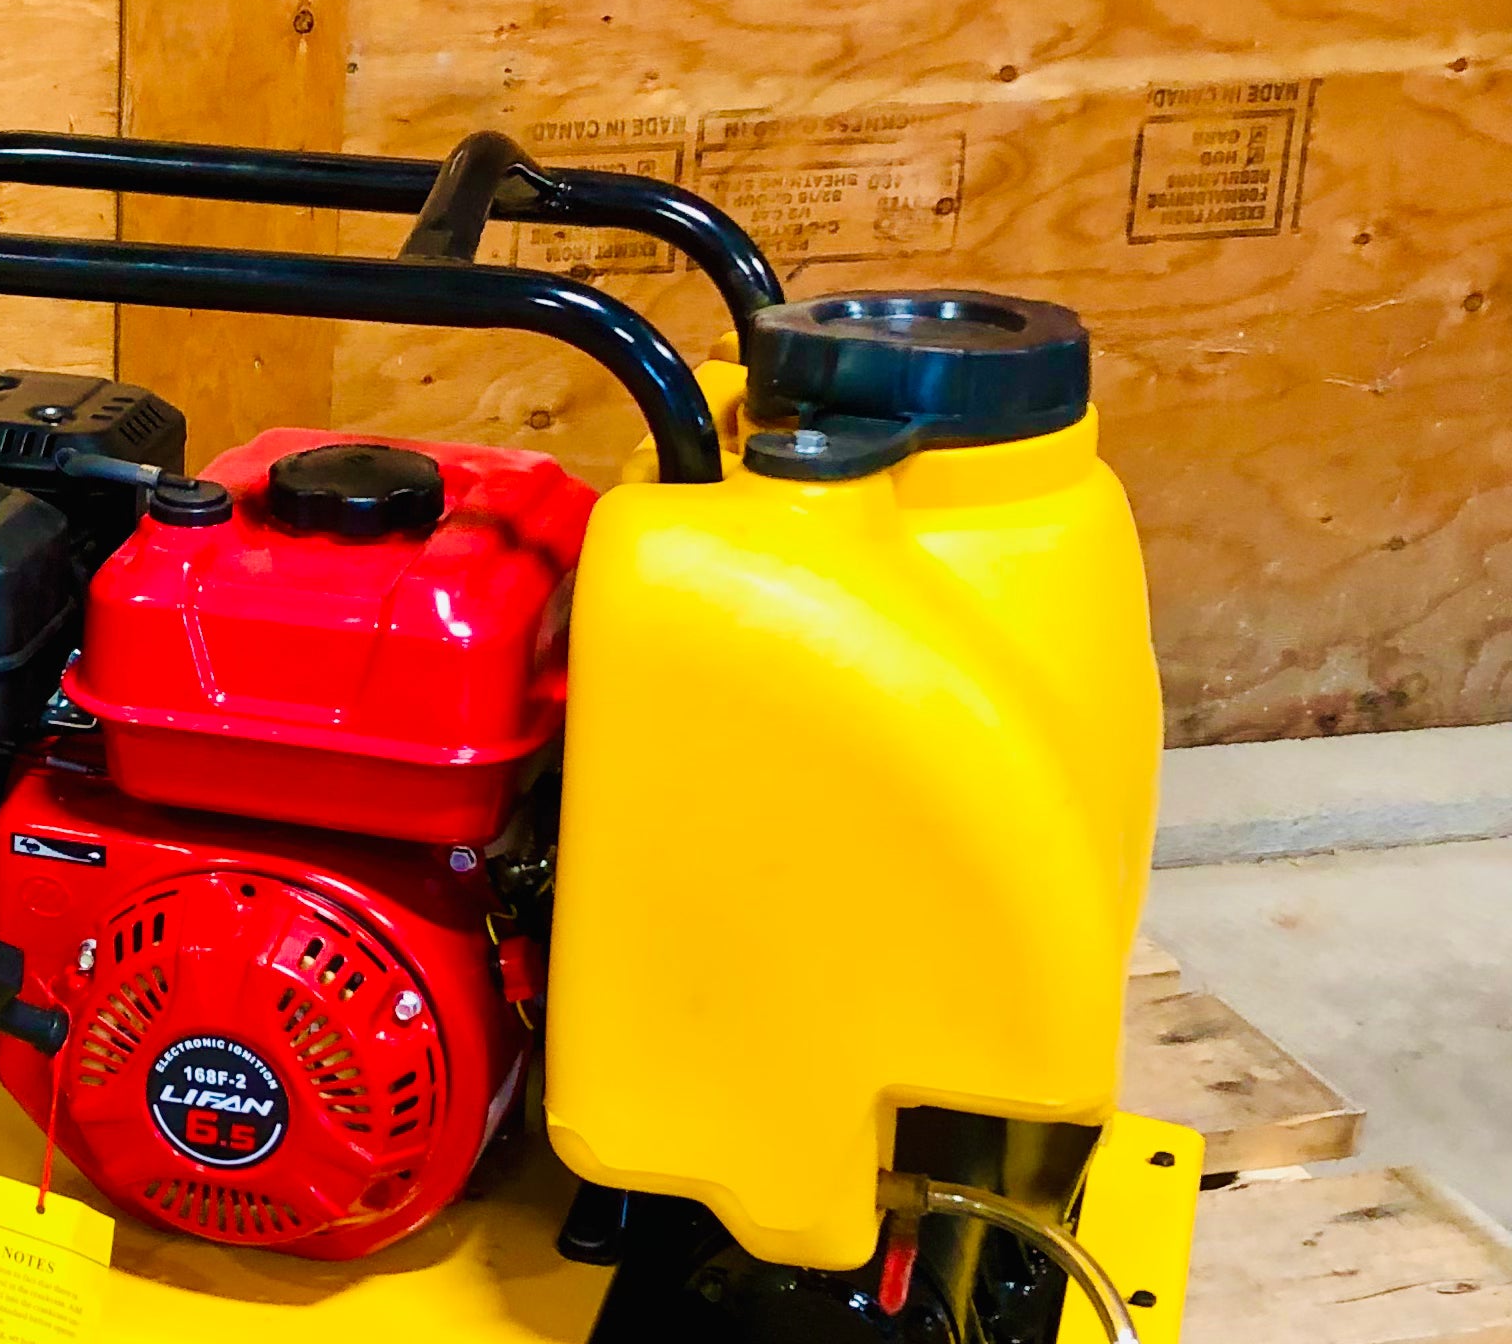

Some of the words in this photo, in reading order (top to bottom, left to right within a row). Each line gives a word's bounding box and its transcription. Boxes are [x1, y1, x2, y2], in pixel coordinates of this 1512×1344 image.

[533, 120, 599, 141] CANAD
[155, 1037, 225, 1073] ELECTRONIC
[228, 1042, 279, 1090] IGNITION
[183, 1065, 247, 1090] 168F-2
[159, 1084, 274, 1117] LIFAN
[185, 1108, 256, 1152] 6.5
[2, 1245, 55, 1274] NOTES
